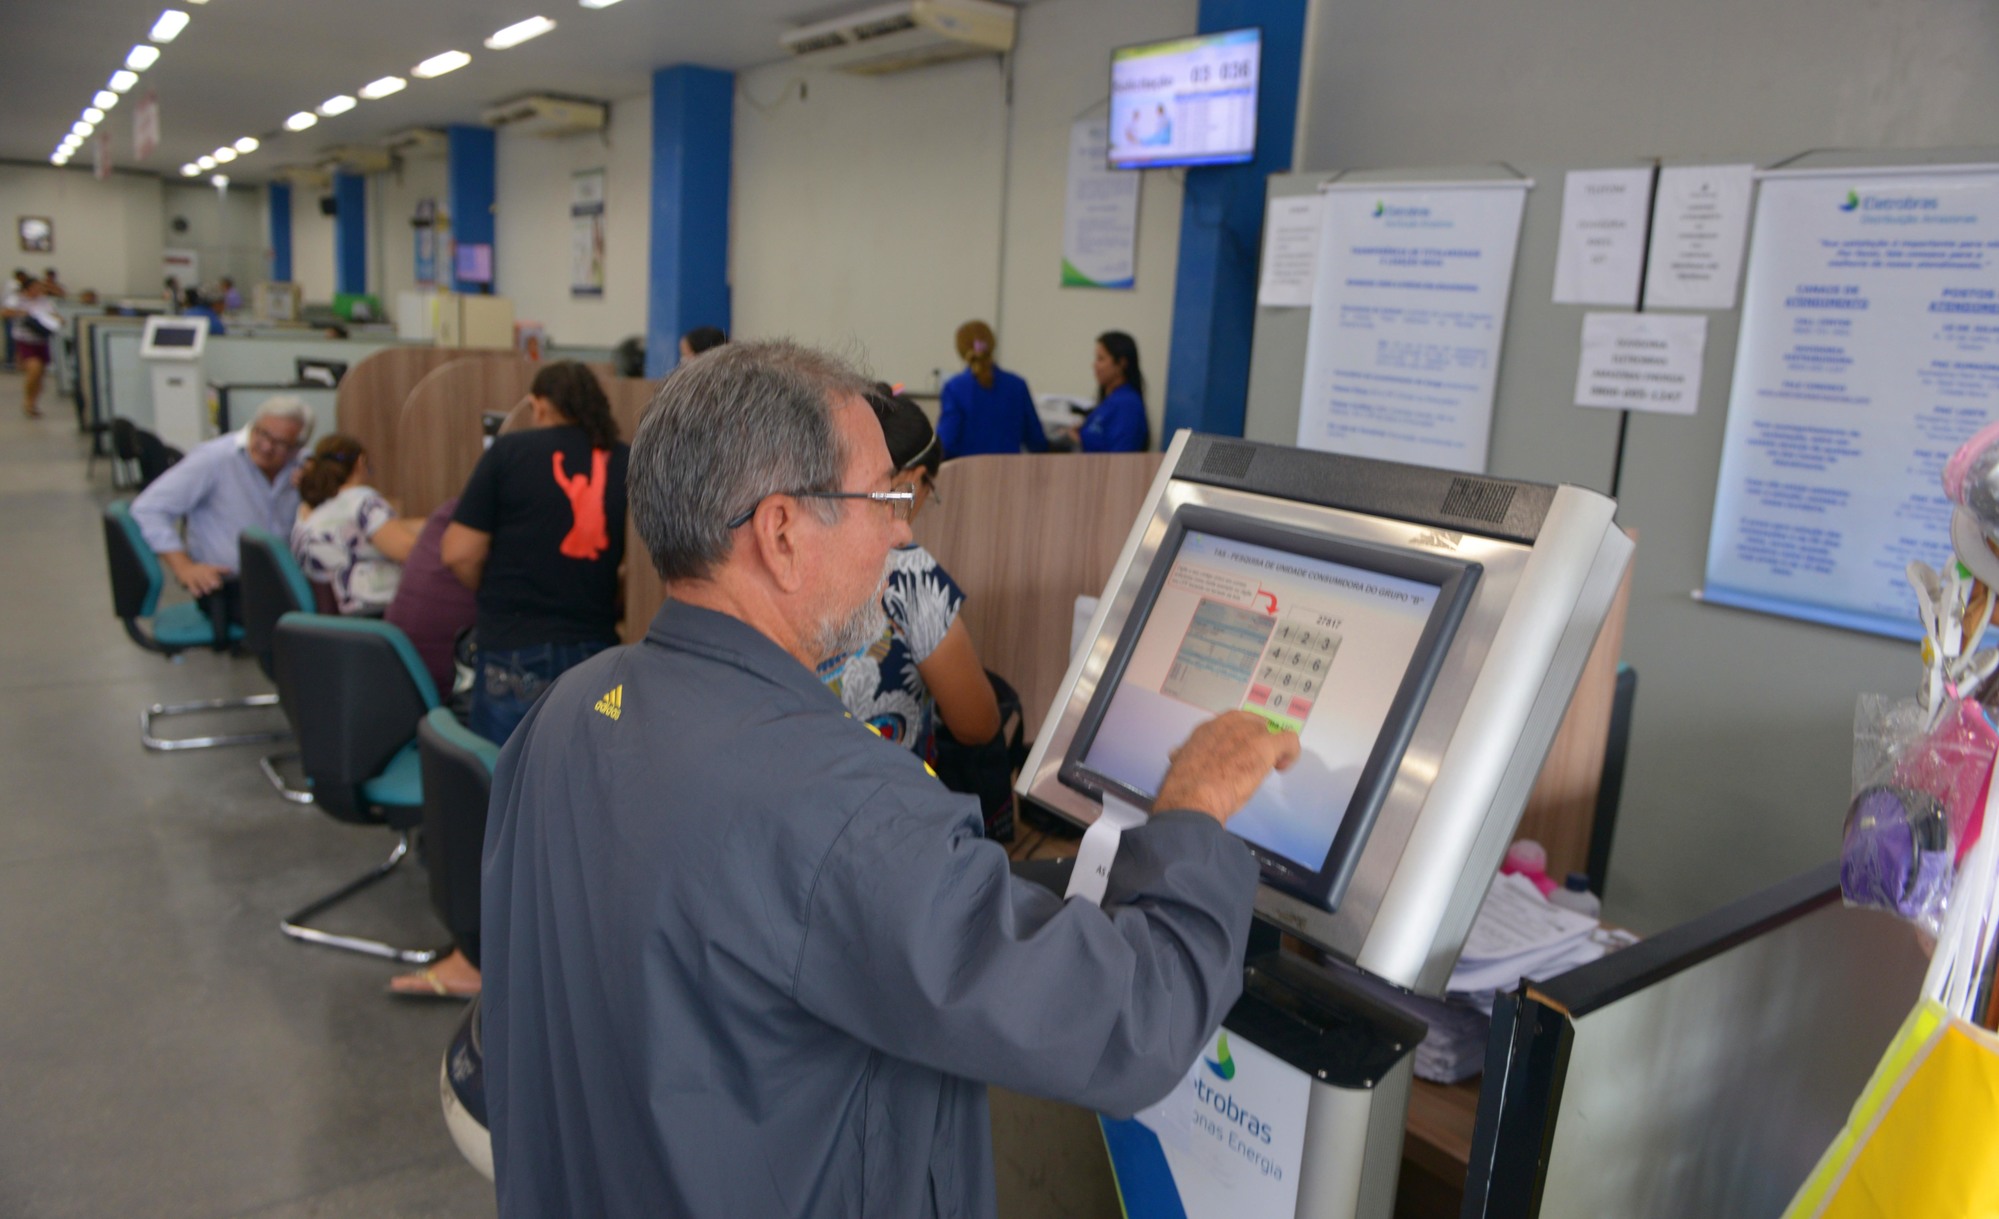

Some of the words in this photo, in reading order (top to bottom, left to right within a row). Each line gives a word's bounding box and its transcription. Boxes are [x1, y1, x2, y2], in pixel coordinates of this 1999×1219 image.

[1863, 196, 1938, 211] Eletrobras
[1231, 551, 1264, 568] PESQUISA
[1265, 560, 1275, 570] DE
[1276, 562, 1308, 578] UNIDADE
[1308, 572, 1364, 593] CONSUMIDORA
[1365, 583, 1378, 596] DO
[1378, 589, 1408, 603] GRUPO
[1316, 615, 1342, 630] 27817
[1282, 626, 1289, 639] 1
[1301, 632, 1310, 645] 2
[1321, 637, 1330, 651] 3
[1272, 647, 1281, 659] 4
[1291, 652, 1301, 665] 5
[1312, 659, 1321, 672] 6
[1264, 667, 1272, 679] 7
[1283, 673, 1292, 686] 8
[1303, 680, 1312, 693] 9
[594, 699, 621, 720] adidas
[1273, 694, 1283, 707] 0
[1194, 1077, 1272, 1145] trobras
[1228, 1130, 1282, 1181] Energia
